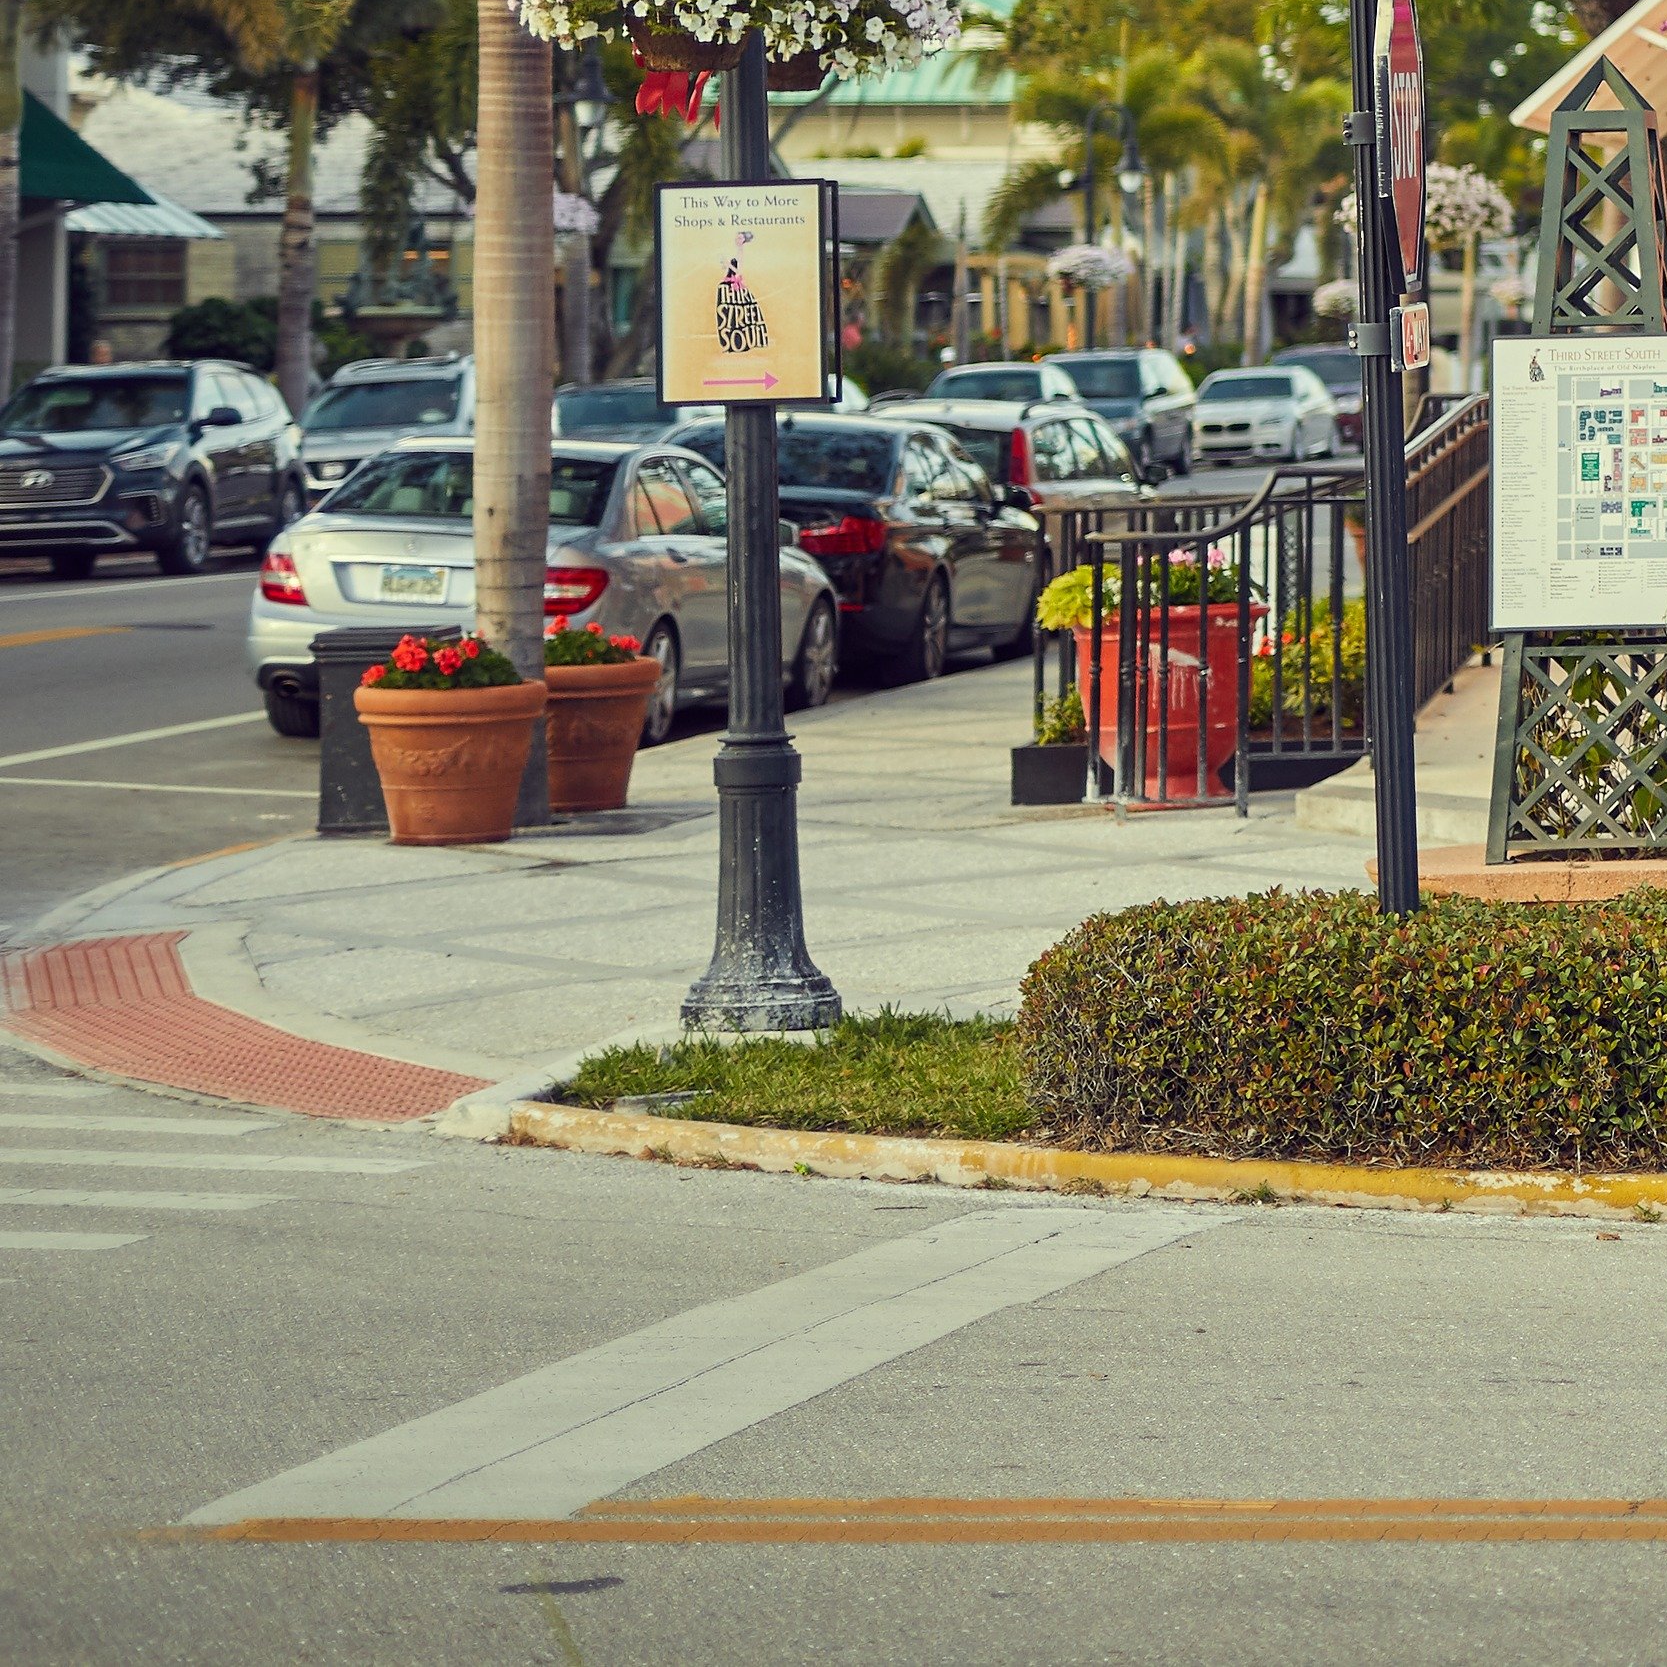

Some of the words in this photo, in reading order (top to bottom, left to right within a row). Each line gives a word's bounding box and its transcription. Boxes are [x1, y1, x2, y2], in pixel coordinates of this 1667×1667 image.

[1393, 72, 1419, 180] STOP
[680, 196, 709, 209] This
[713, 195, 741, 210] Way
[746, 197, 760, 208] to
[764, 194, 800, 207] More
[674, 215, 713, 230] Shops
[717, 217, 726, 227] &
[731, 213, 806, 227] Restaurants
[716, 303, 766, 331] STREET
[719, 324, 769, 353] SOUTH
[1548, 348, 1582, 362] THIRD
[1584, 348, 1621, 361] STREET
[1624, 347, 1661, 360] SOUTH
